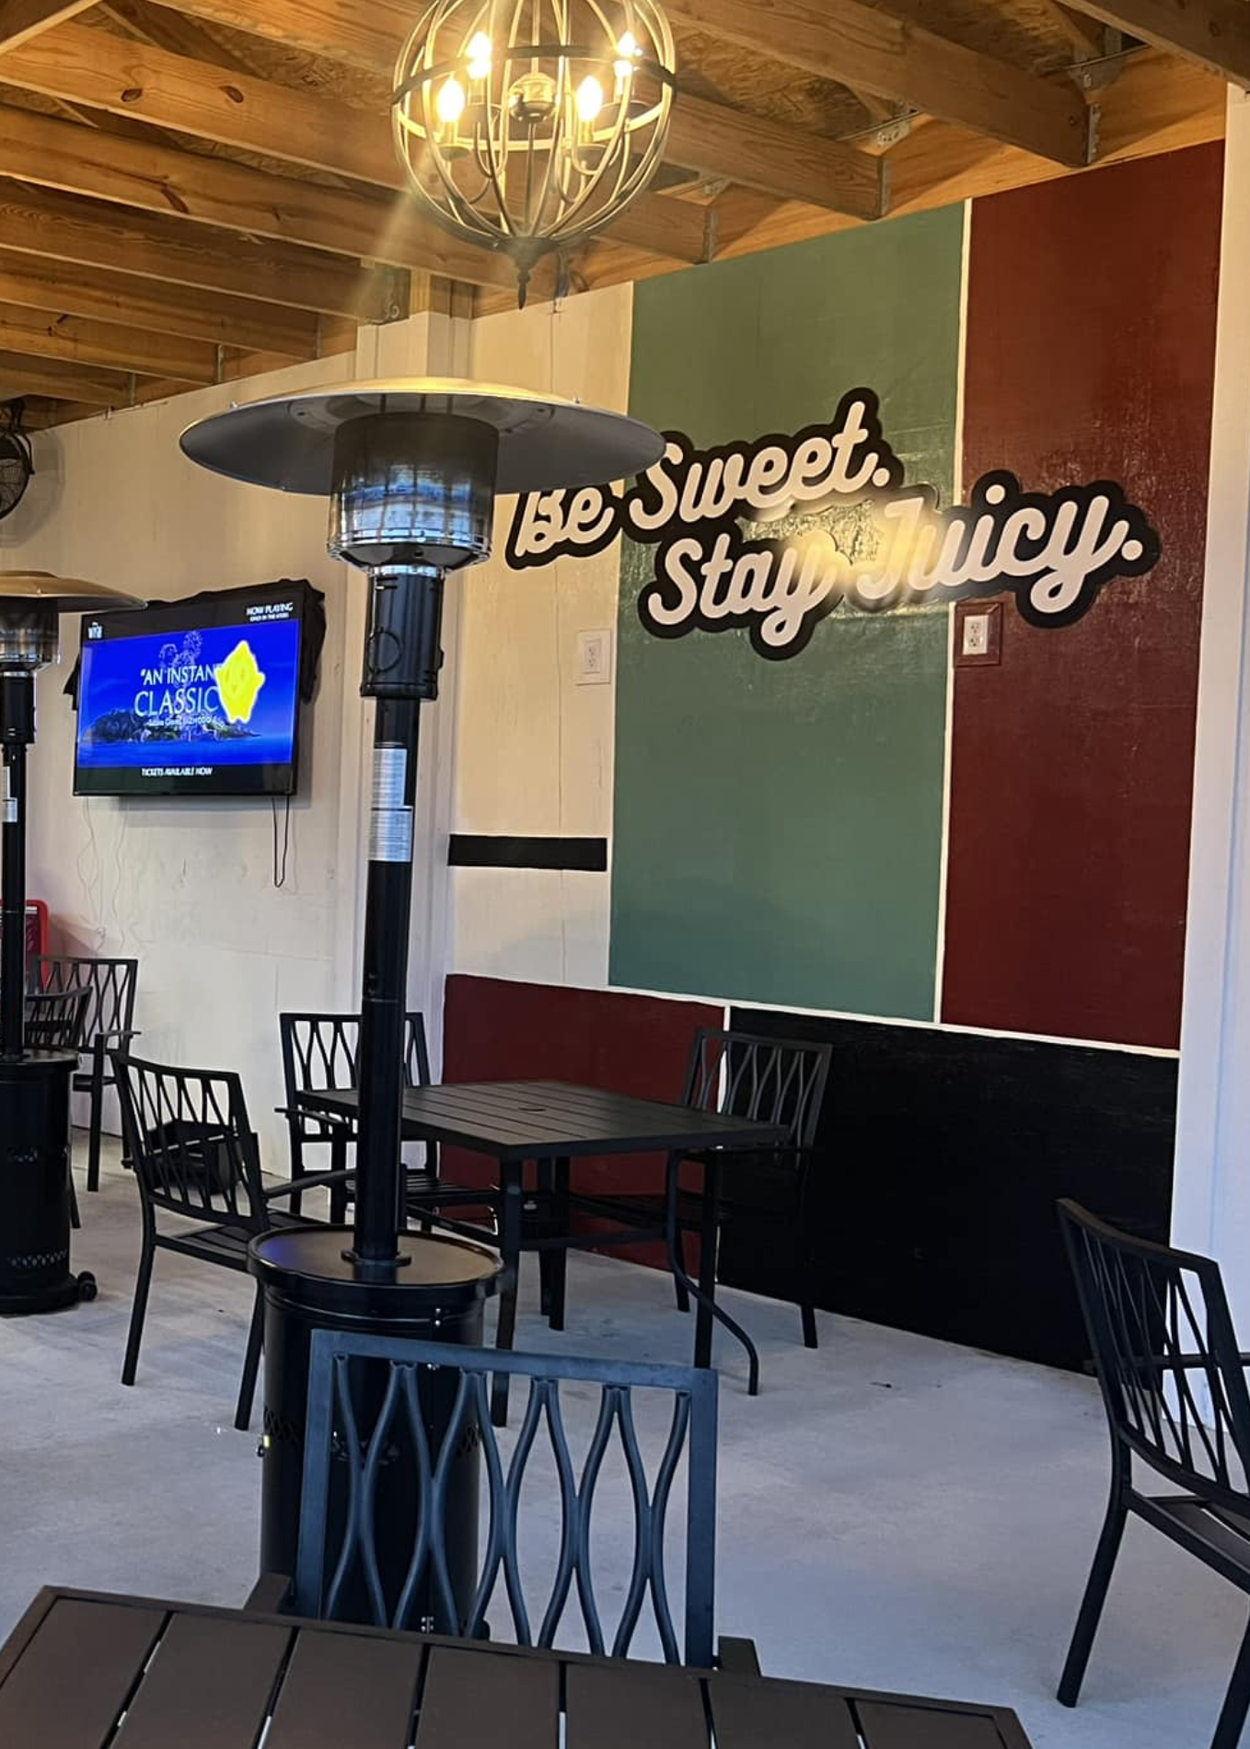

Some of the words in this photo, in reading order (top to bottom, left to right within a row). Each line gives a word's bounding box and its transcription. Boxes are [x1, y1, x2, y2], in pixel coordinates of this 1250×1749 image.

[512, 486, 616, 558] Be
[628, 400, 892, 531] Sweet.
[647, 531, 838, 648] Stay
[854, 484, 1144, 614] Juicy.
[134, 686, 220, 717] CLASSIC
